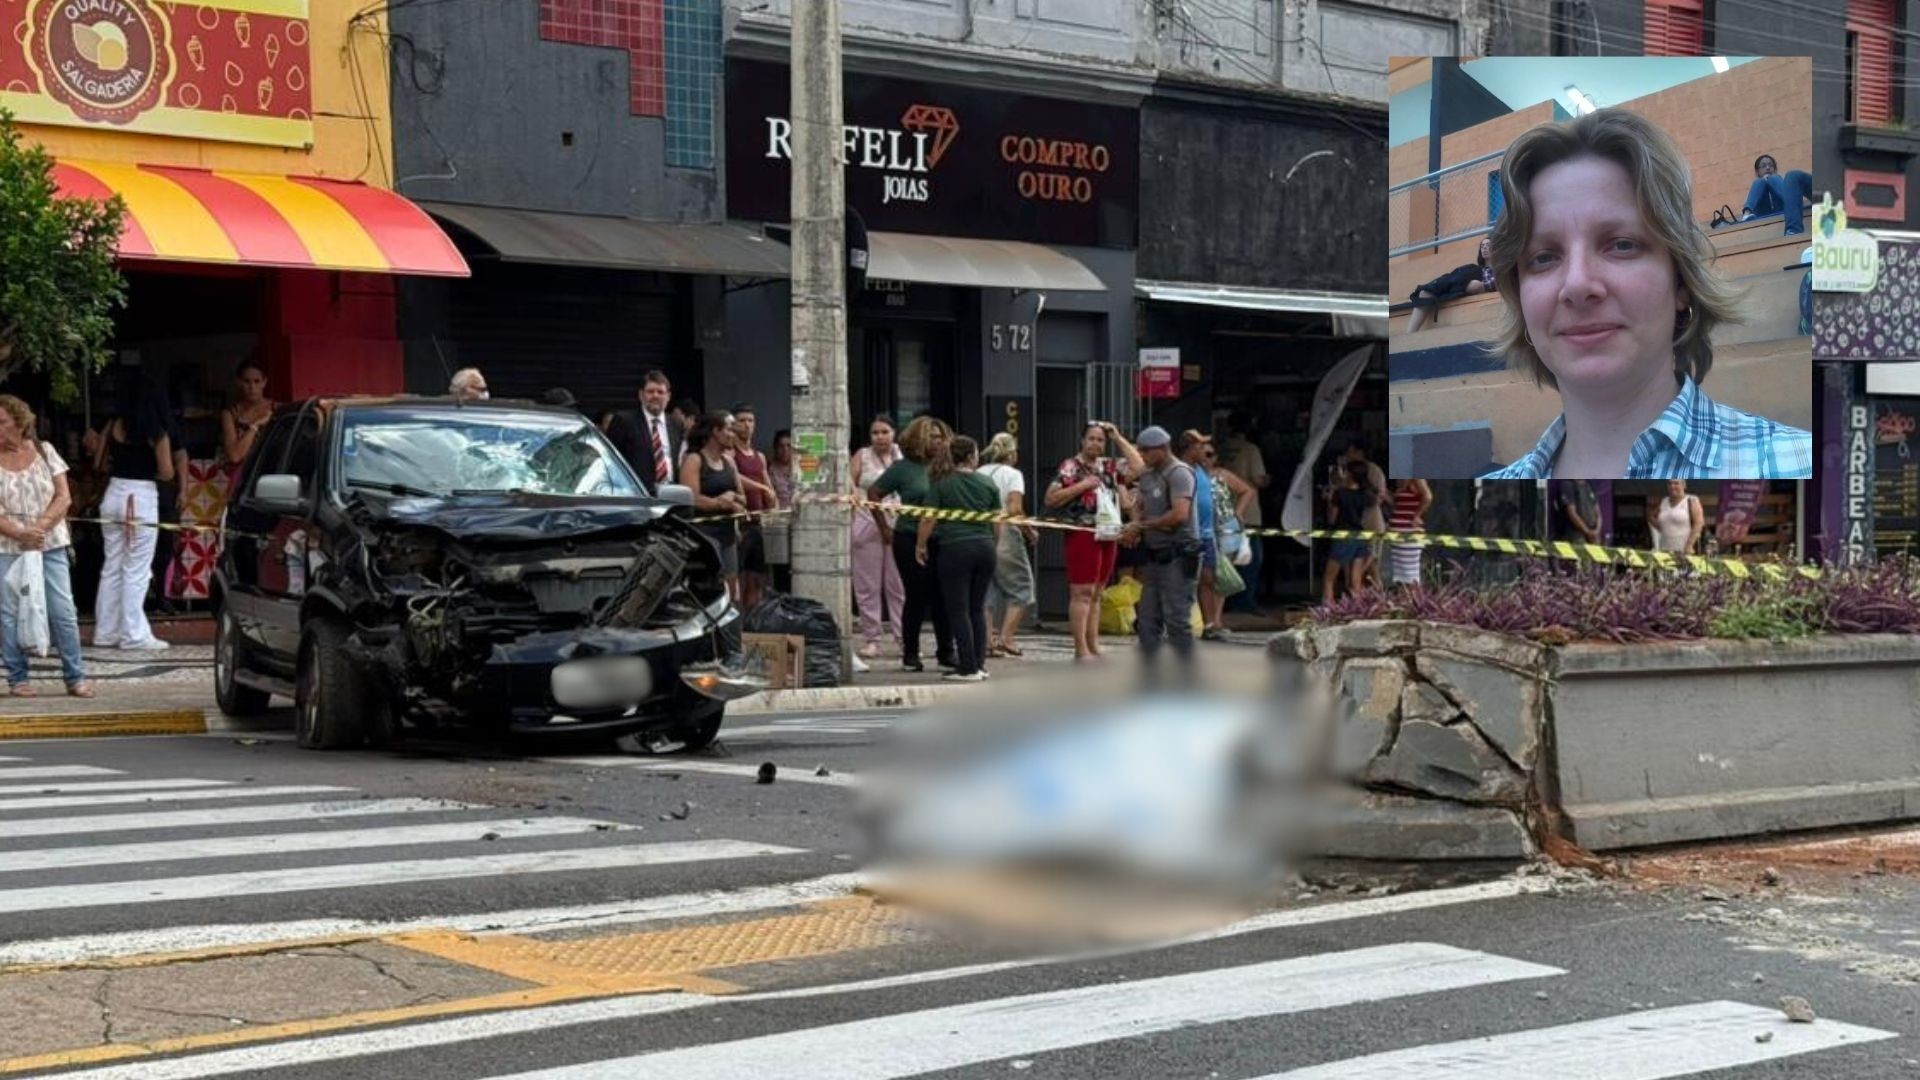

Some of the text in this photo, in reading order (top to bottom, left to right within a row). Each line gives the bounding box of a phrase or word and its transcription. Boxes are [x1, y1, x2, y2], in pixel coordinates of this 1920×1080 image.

[64, 0, 136, 26] QUALITY
[61, 60, 144, 99] SALGADERIA
[765, 116, 928, 172] RFELI
[1001, 135, 1110, 172] COMPRO
[883, 176, 928, 204] JOIAS
[1018, 170, 1092, 203] OURO
[1814, 241, 1872, 271] Bauru
[1849, 404, 1867, 566] BARBEAR
